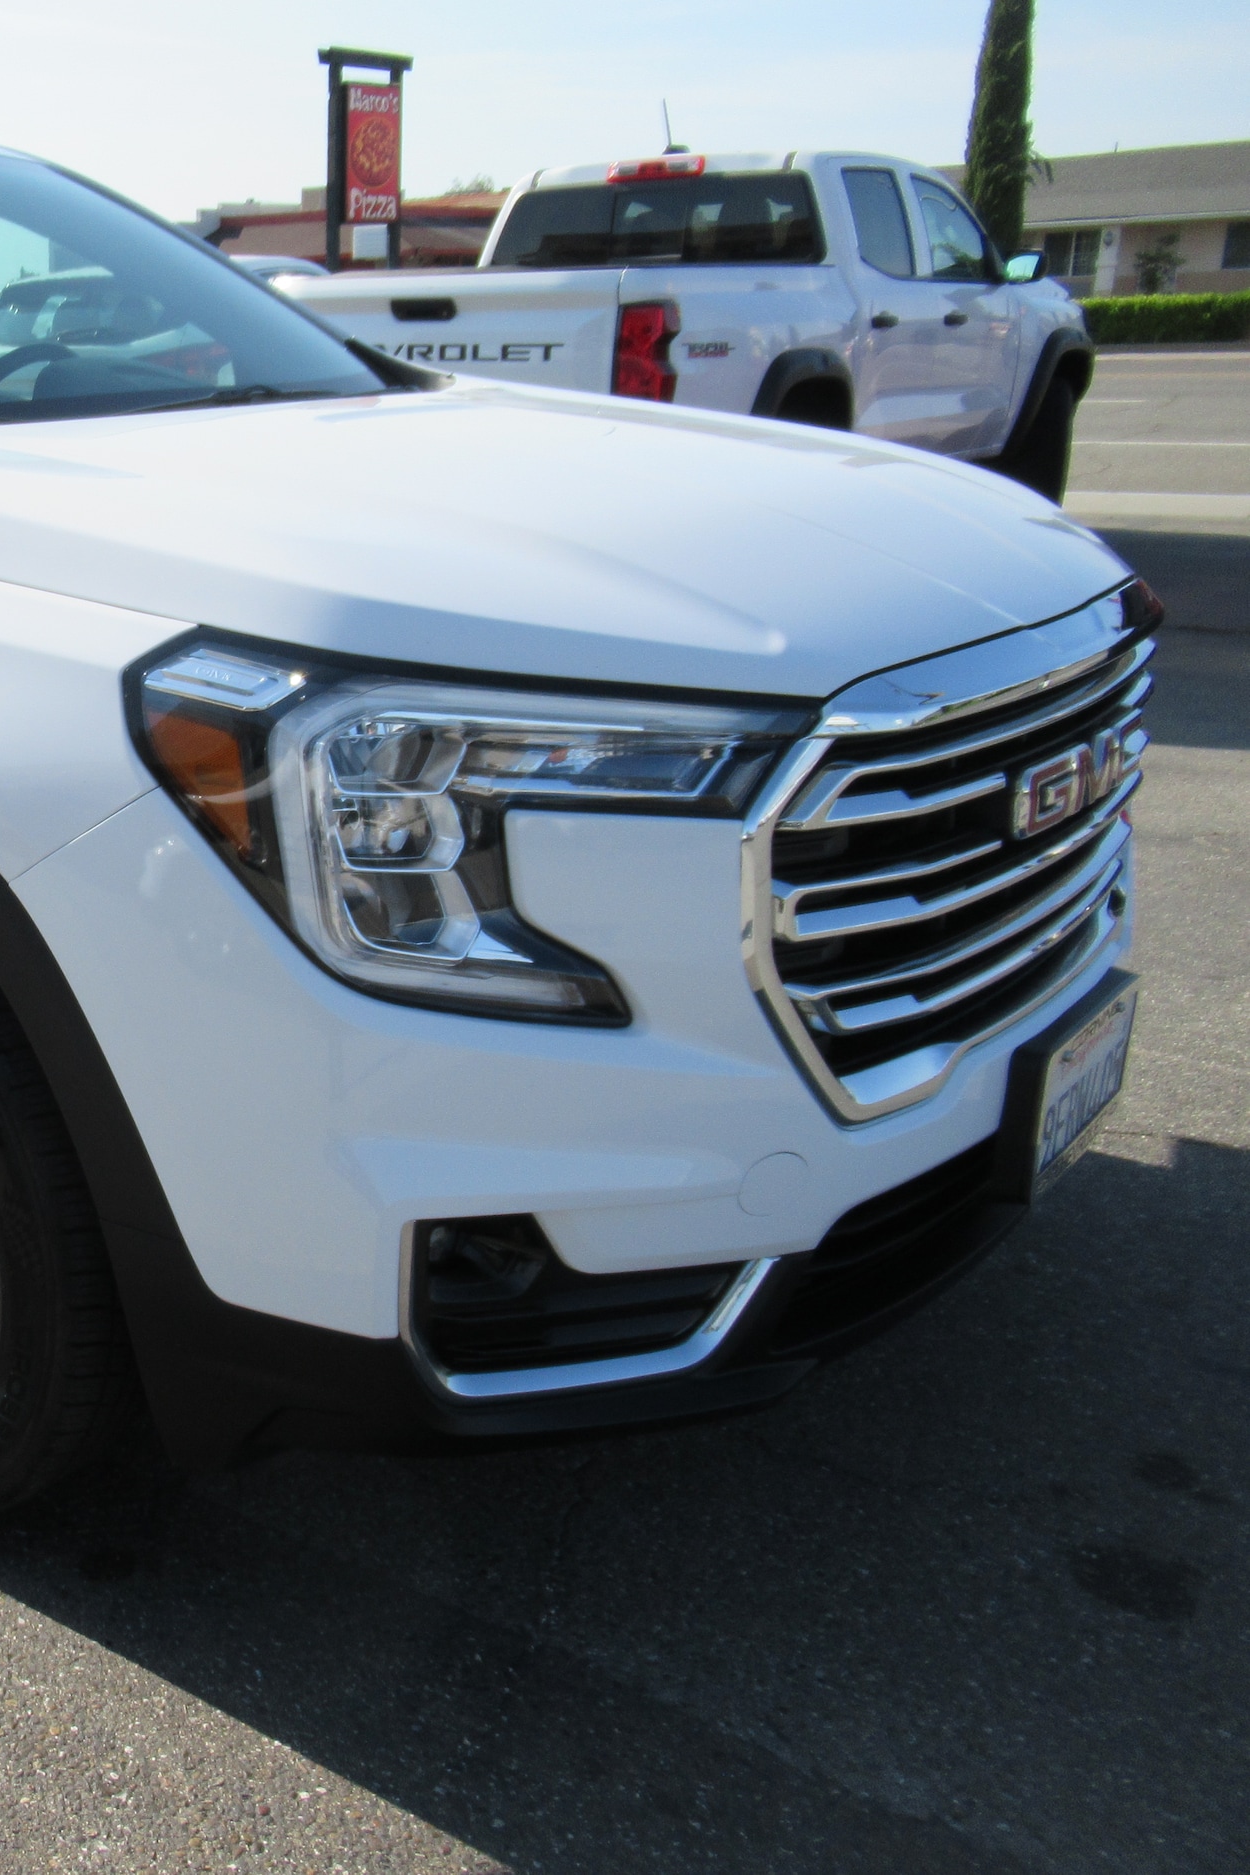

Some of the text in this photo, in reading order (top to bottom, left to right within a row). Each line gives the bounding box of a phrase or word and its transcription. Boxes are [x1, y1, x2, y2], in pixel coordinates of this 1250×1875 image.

[350, 87, 399, 114] Marco's
[349, 186, 397, 219] Pizza
[1015, 708, 1143, 839] GMC
